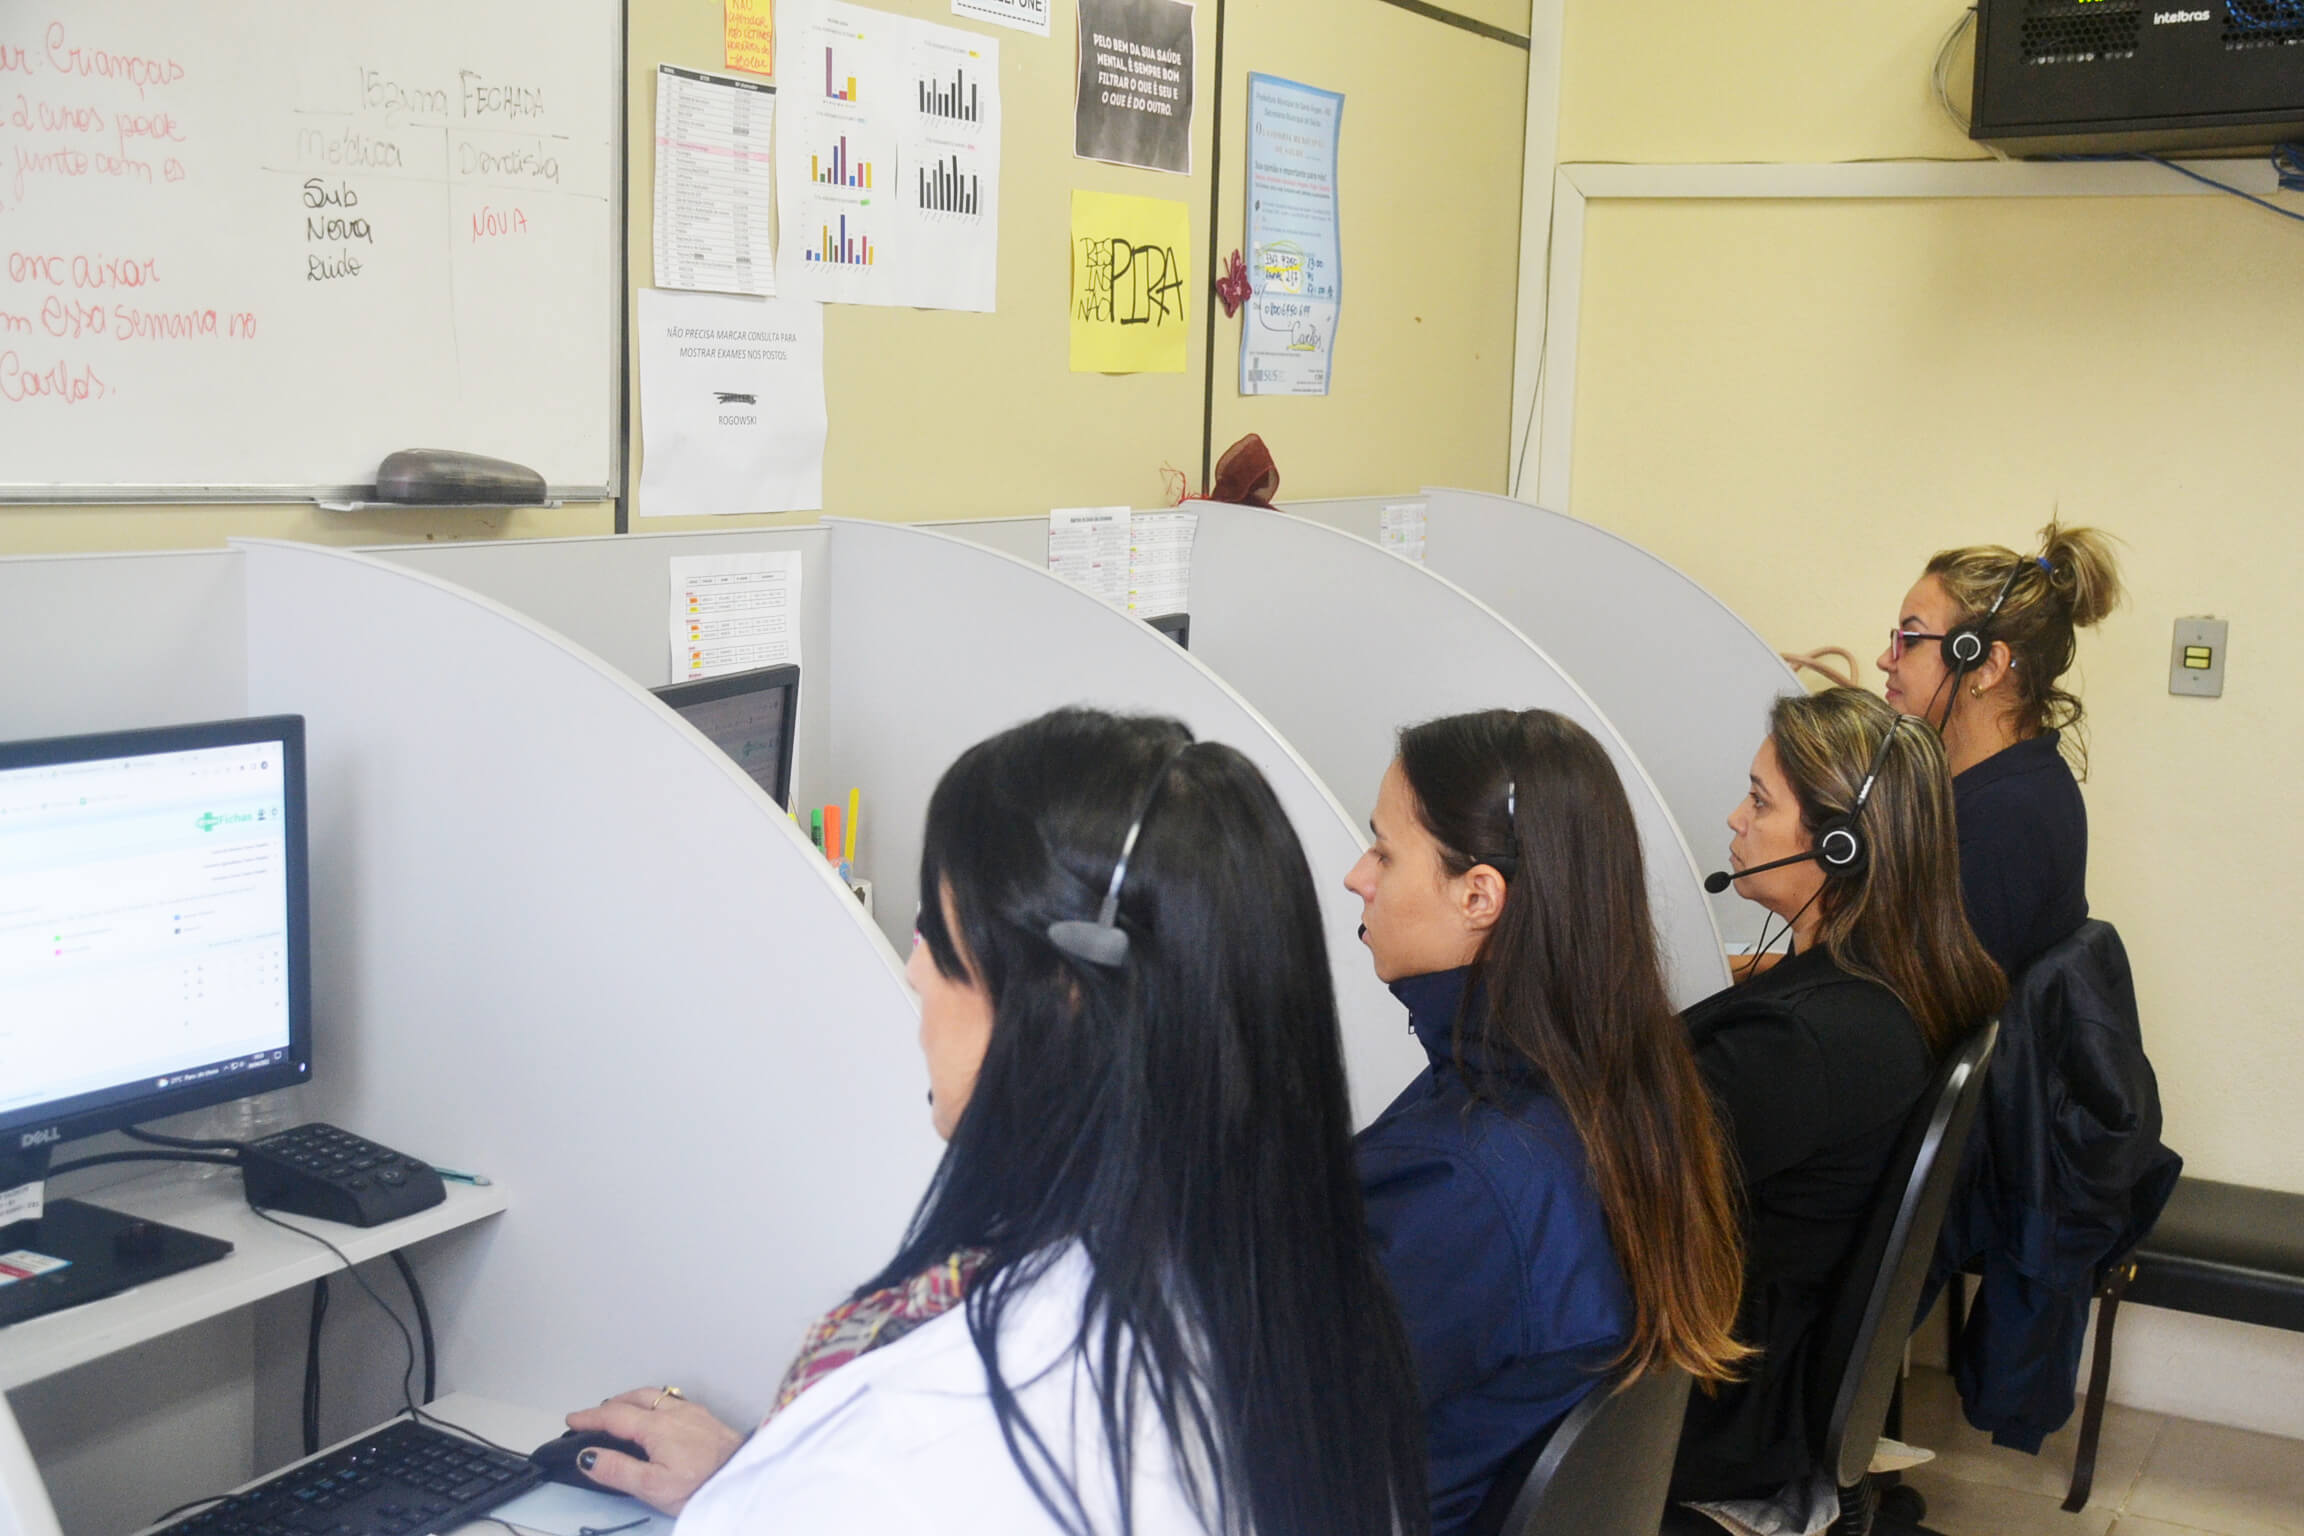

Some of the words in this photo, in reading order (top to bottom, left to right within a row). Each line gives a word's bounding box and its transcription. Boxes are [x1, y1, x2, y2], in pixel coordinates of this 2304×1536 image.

[2153, 10, 2210, 25] intelbras
[1093, 33, 1112, 49] PELO
[1113, 38, 1129, 54] BEM
[1129, 42, 1141, 57] DA
[1141, 45, 1156, 60] SUA
[1156, 48, 1182, 65] SAÚDE
[1097, 53, 1127, 72] MENTAL,
[1128, 57, 1133, 72] É
[1134, 61, 1161, 79] SEMPRE
[1162, 67, 1180, 82] BOM
[458, 68, 545, 120] FECHADA
[1098, 71, 1129, 90] FILTRAR
[1130, 79, 1137, 91] O
[1138, 80, 1152, 94] QUE
[1153, 81, 1158, 95] É
[1158, 87, 1172, 98] SEU
[1172, 87, 1178, 100] E
[1101, 91, 1109, 103] O
[1109, 93, 1126, 107] QUE
[1127, 93, 1133, 108] É
[1133, 98, 1145, 111] DO
[1146, 100, 1172, 116] OUTRO.
[458, 139, 560, 185] Dentista
[303, 177, 358, 208] Sub
[472, 206, 528, 244] NOVA
[1110, 238, 1183, 328] PIRA
[666, 326, 684, 338] NÃO
[684, 327, 715, 340] PRECISA
[716, 330, 747, 341] MARCAR
[747, 331, 779, 342] CONSULTA
[780, 333, 798, 342] PARA
[679, 347, 716, 358] MOSTRAR
[717, 349, 746, 360] EXAMES
[747, 350, 761, 360] NOS
[718, 415, 757, 426] ROGOWSKI
[22, 1127, 61, 1148] DELL
